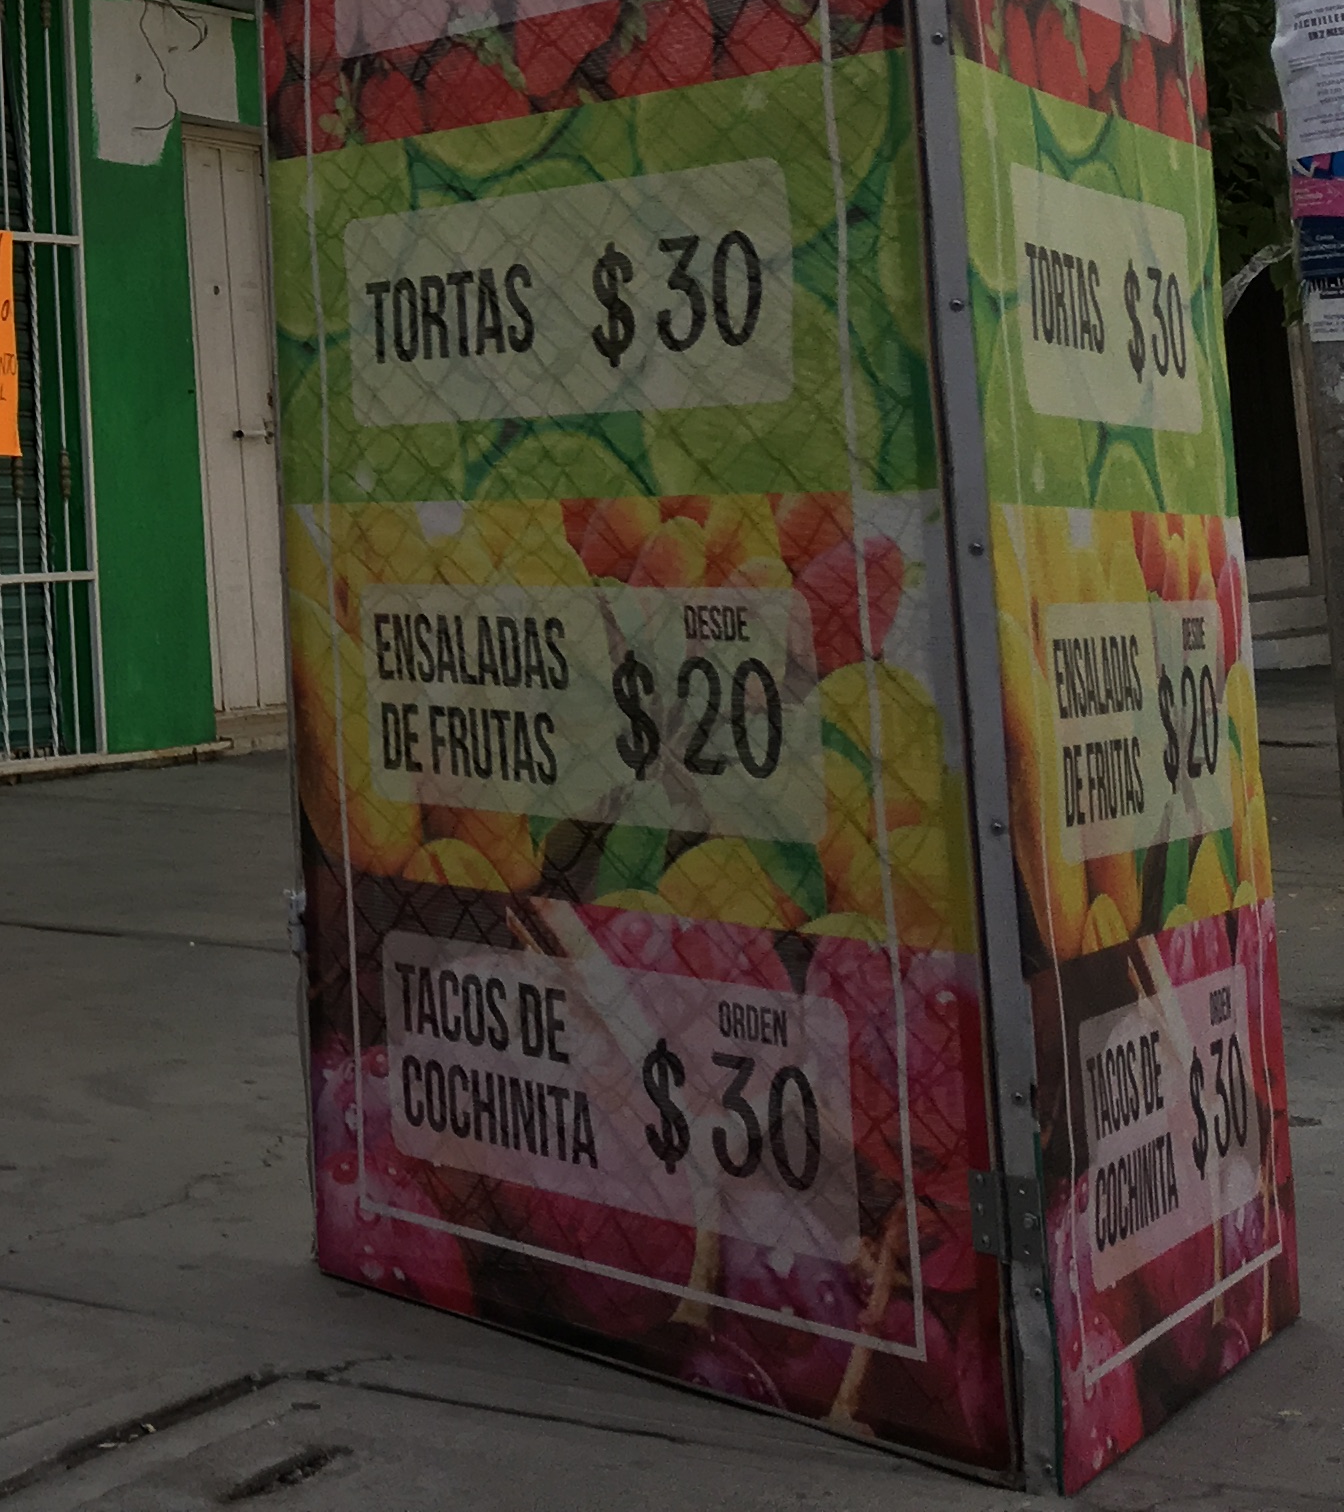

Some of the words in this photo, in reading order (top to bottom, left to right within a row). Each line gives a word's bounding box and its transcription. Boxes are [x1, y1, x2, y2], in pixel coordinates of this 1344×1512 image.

[365, 263, 536, 365] TORTAS
[1024, 241, 1106, 355] TORTAS
[372, 612, 571, 692] ENSALADAS
[683, 604, 751, 643] DESDE
[1052, 636, 1144, 720] ENSALADAS
[381, 703, 421, 772] DE
[430, 704, 559, 787] FRUTAS
[1063, 744, 1084, 829] DE
[1086, 740, 1146, 824] FRUTAS
[395, 959, 509, 1053] TACOS
[518, 981, 571, 1065] DE
[717, 998, 789, 1049] ORDEN
[400, 1053, 599, 1170] COCHINITA
[1087, 1040, 1141, 1141] TACOS
[1142, 1029, 1165, 1115] DE
[1094, 1131, 1180, 1252] COCHINITA
